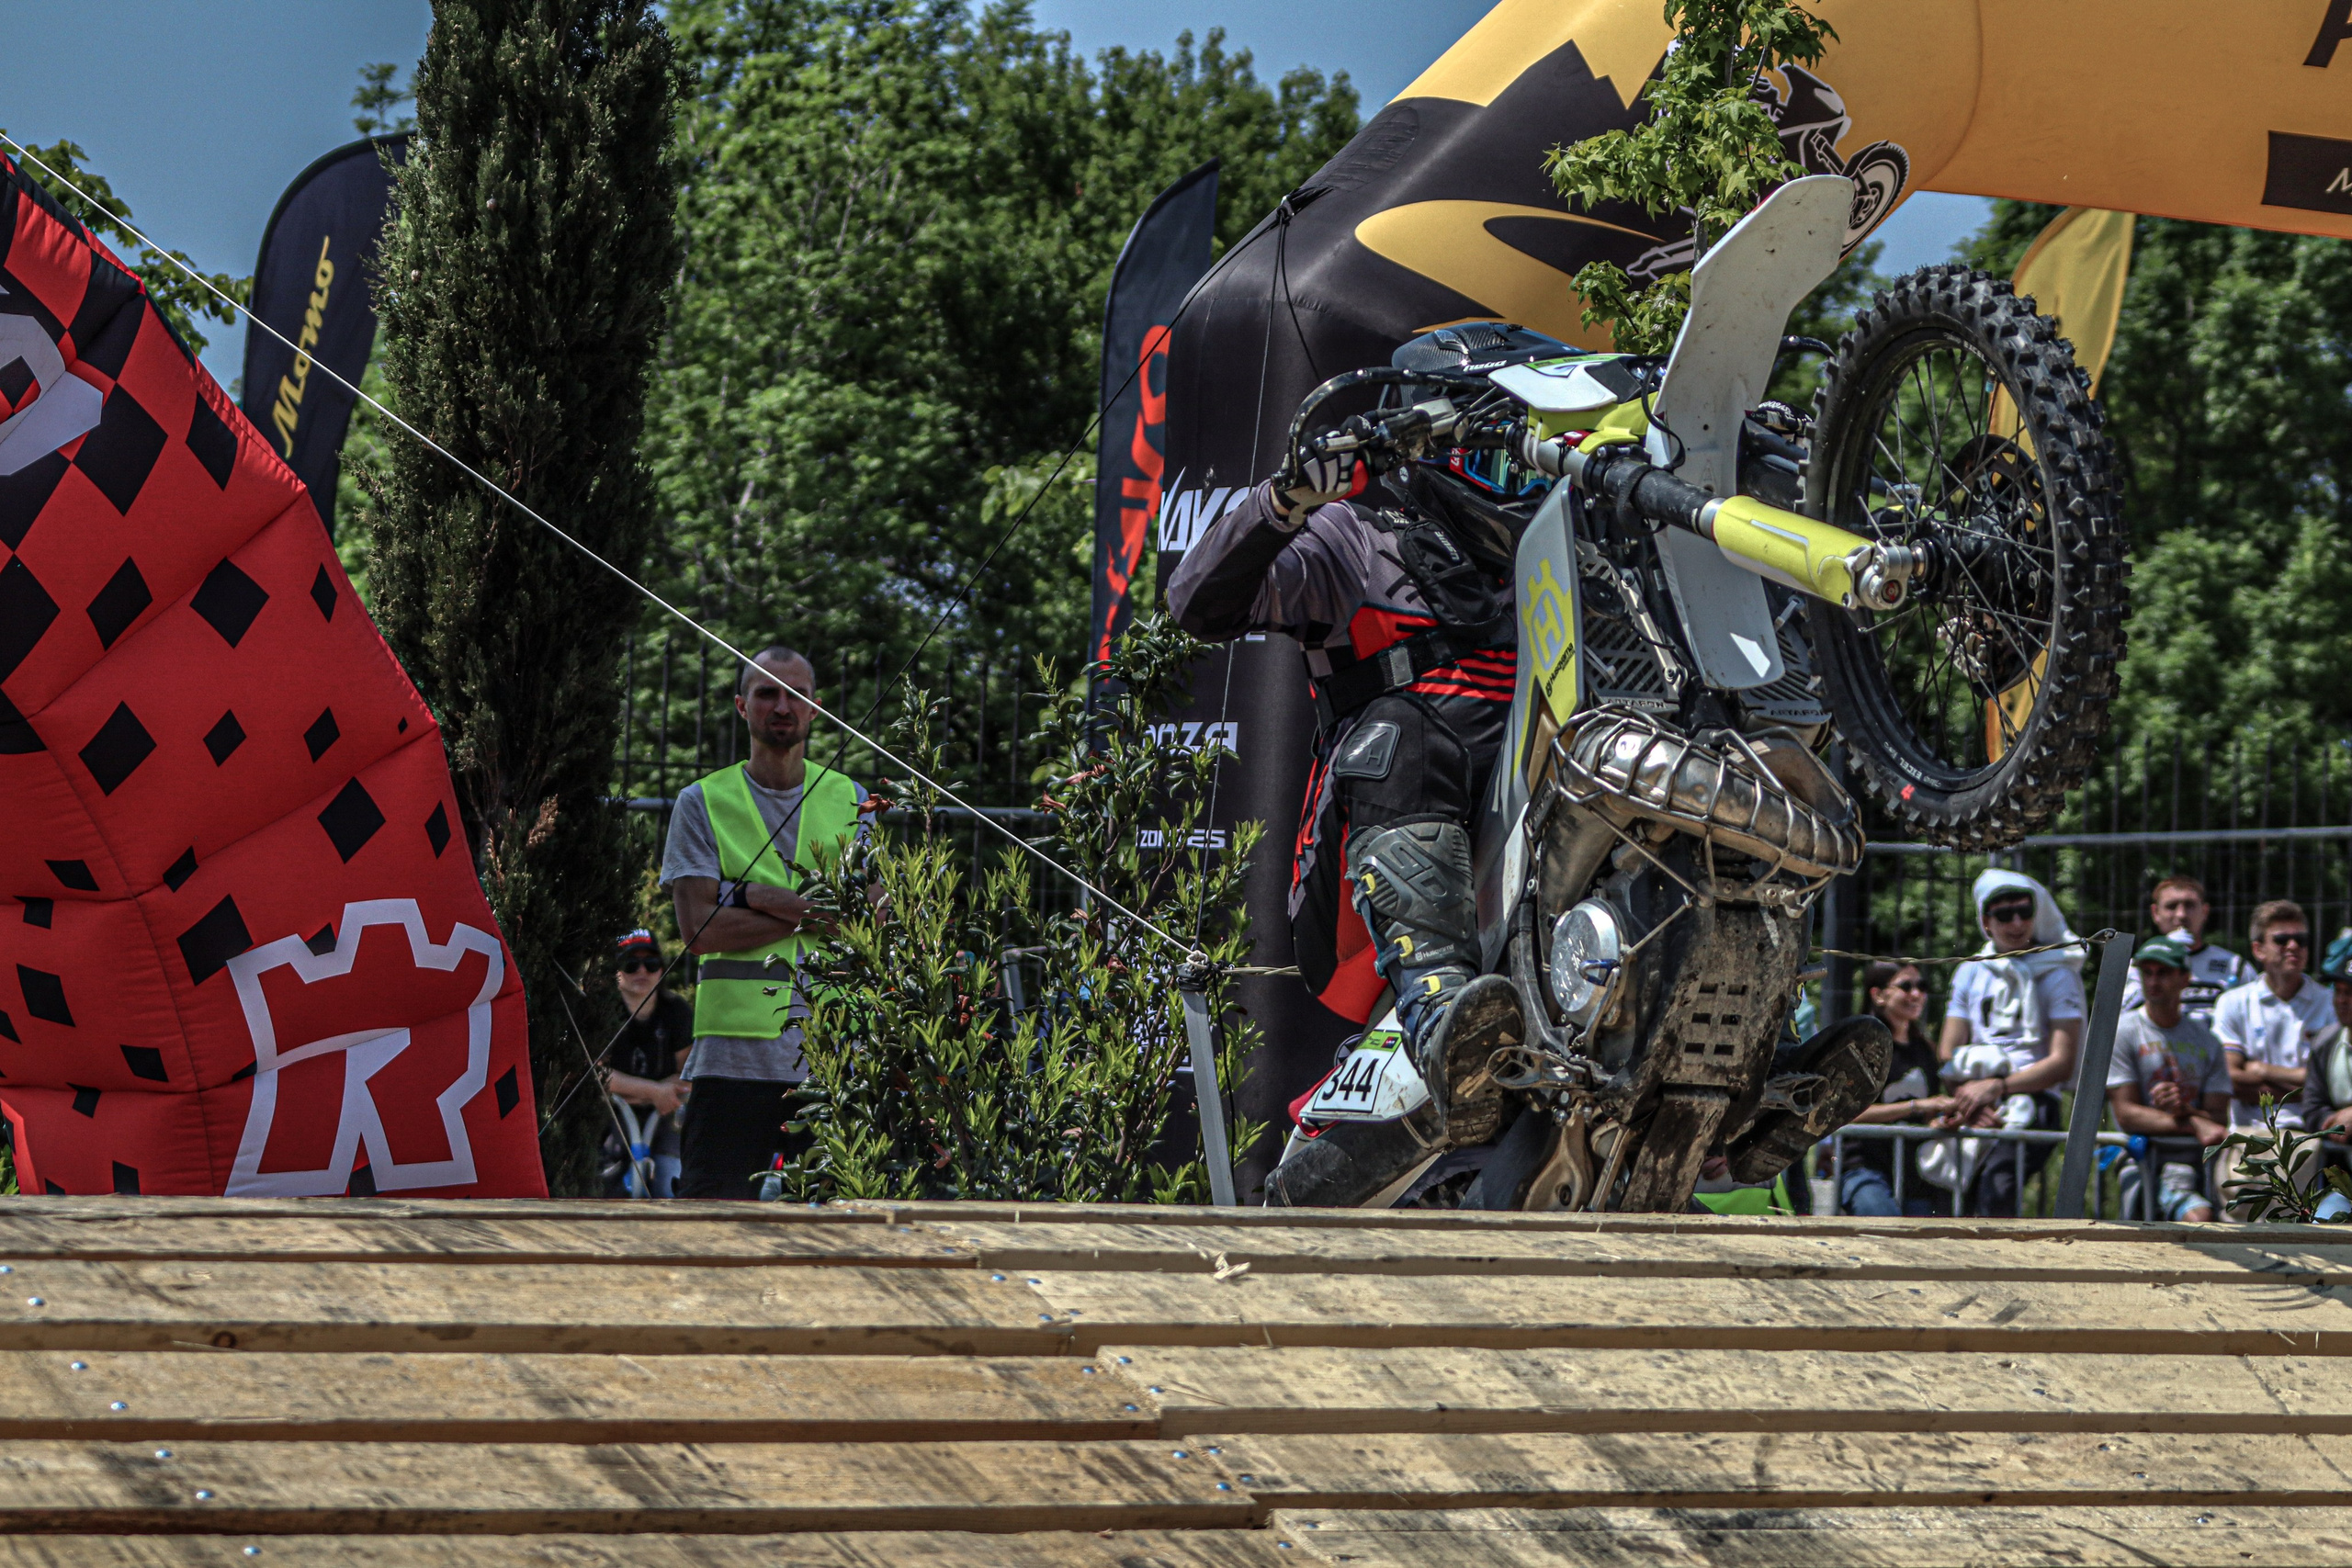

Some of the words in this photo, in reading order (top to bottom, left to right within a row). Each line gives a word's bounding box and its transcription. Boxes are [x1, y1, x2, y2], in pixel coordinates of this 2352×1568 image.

[272, 235, 334, 458] Momo
[1900, 758, 1924, 780] EXCEL
[1321, 1057, 1379, 1102] 344
